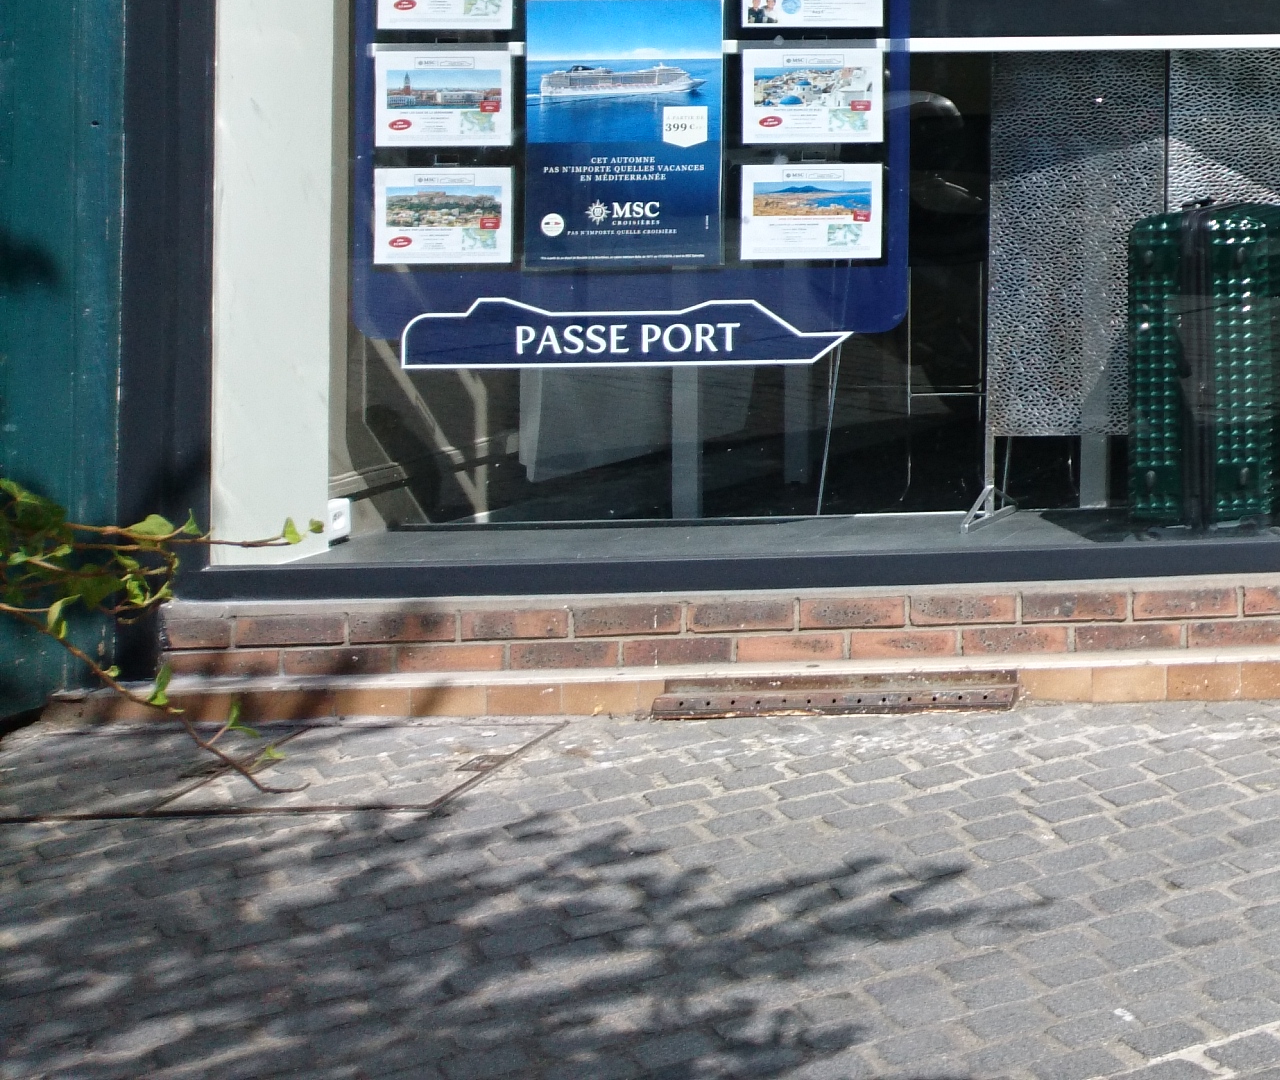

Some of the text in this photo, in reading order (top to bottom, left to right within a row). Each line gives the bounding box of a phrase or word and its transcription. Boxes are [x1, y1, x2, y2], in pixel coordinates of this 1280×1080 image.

[665, 123, 688, 132] 399
[611, 156, 656, 164] AUTOMNE
[614, 165, 655, 173] QUELLES
[657, 164, 705, 172] VACANCES
[595, 173, 667, 182] MÉDITERRANÉE
[612, 201, 660, 218] MSC
[514, 321, 742, 356] PASSE PORT
